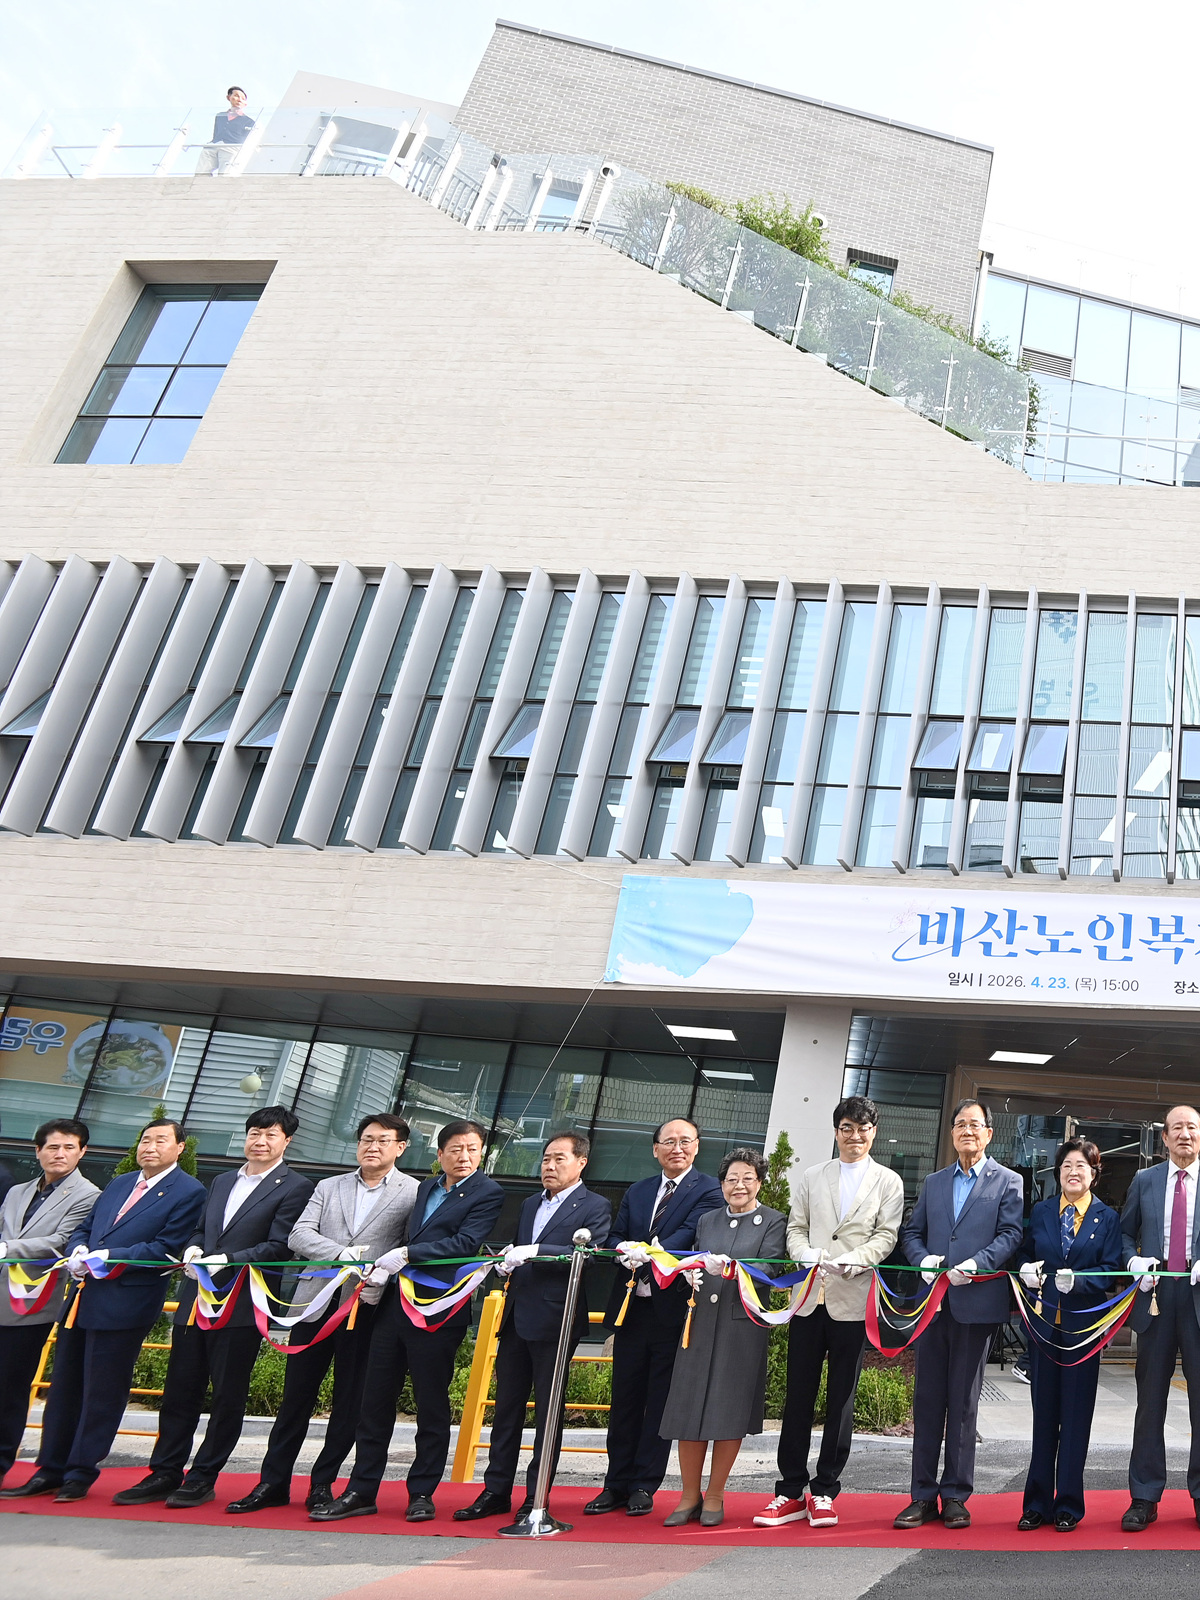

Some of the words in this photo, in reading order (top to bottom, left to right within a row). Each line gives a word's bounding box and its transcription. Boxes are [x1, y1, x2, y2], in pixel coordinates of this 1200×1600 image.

[948, 972, 973, 987] 일시
[987, 974, 1026, 988] 2026.
[1030, 976, 1044, 989] 4.
[1047, 977, 1070, 989] 23.
[1075, 977, 1098, 992] (목)
[1102, 979, 1139, 992] 15:00
[1173, 980, 1200, 995] 장소
